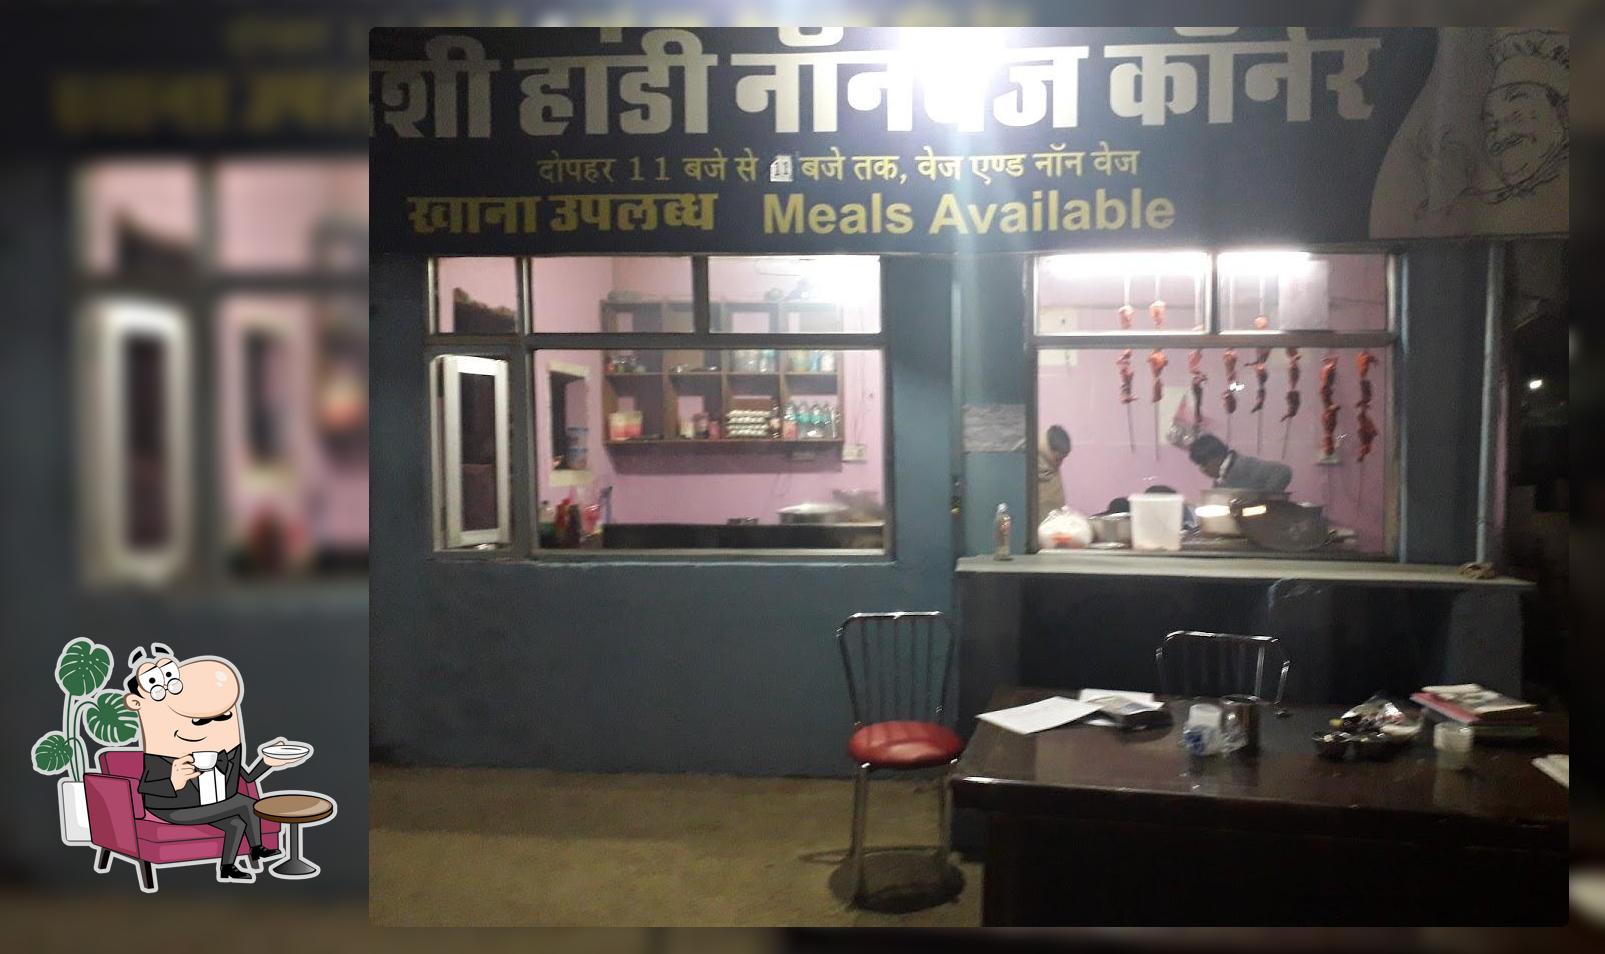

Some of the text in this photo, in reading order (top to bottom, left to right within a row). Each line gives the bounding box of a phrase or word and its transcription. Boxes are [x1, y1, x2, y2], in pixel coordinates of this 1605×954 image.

[369, 35, 500, 138] शी
[537, 150, 616, 184] दोपहर
[682, 148, 728, 180] बजे
[735, 148, 759, 182] से
[800, 147, 845, 179] बजे
[916, 146, 962, 181] वेज
[1033, 143, 1086, 177] नॉन
[1091, 141, 1140, 176] वेज
[407, 193, 719, 234] खाना उपलब्ध
[763, 187, 1177, 236] Meals Available
